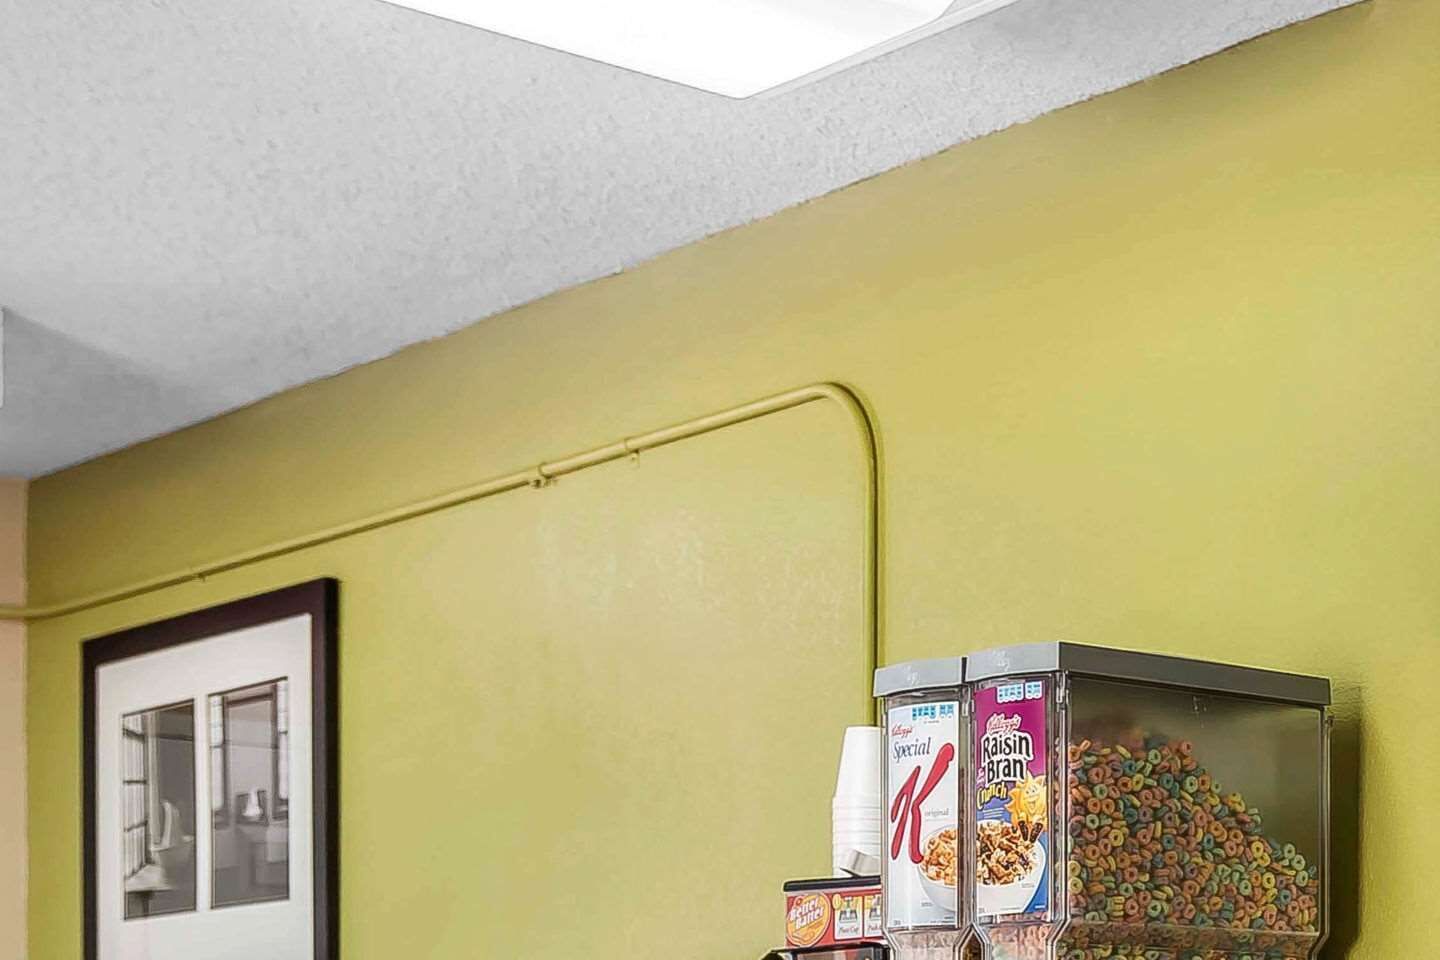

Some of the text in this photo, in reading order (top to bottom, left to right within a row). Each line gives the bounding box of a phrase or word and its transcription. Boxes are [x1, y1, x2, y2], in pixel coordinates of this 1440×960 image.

[893, 737, 931, 763] Special
[983, 734, 1031, 763] Raisin
[986, 758, 1025, 782] Bran
[891, 742, 955, 864] K
[977, 783, 1008, 811] Crunch
[925, 808, 950, 819] original
